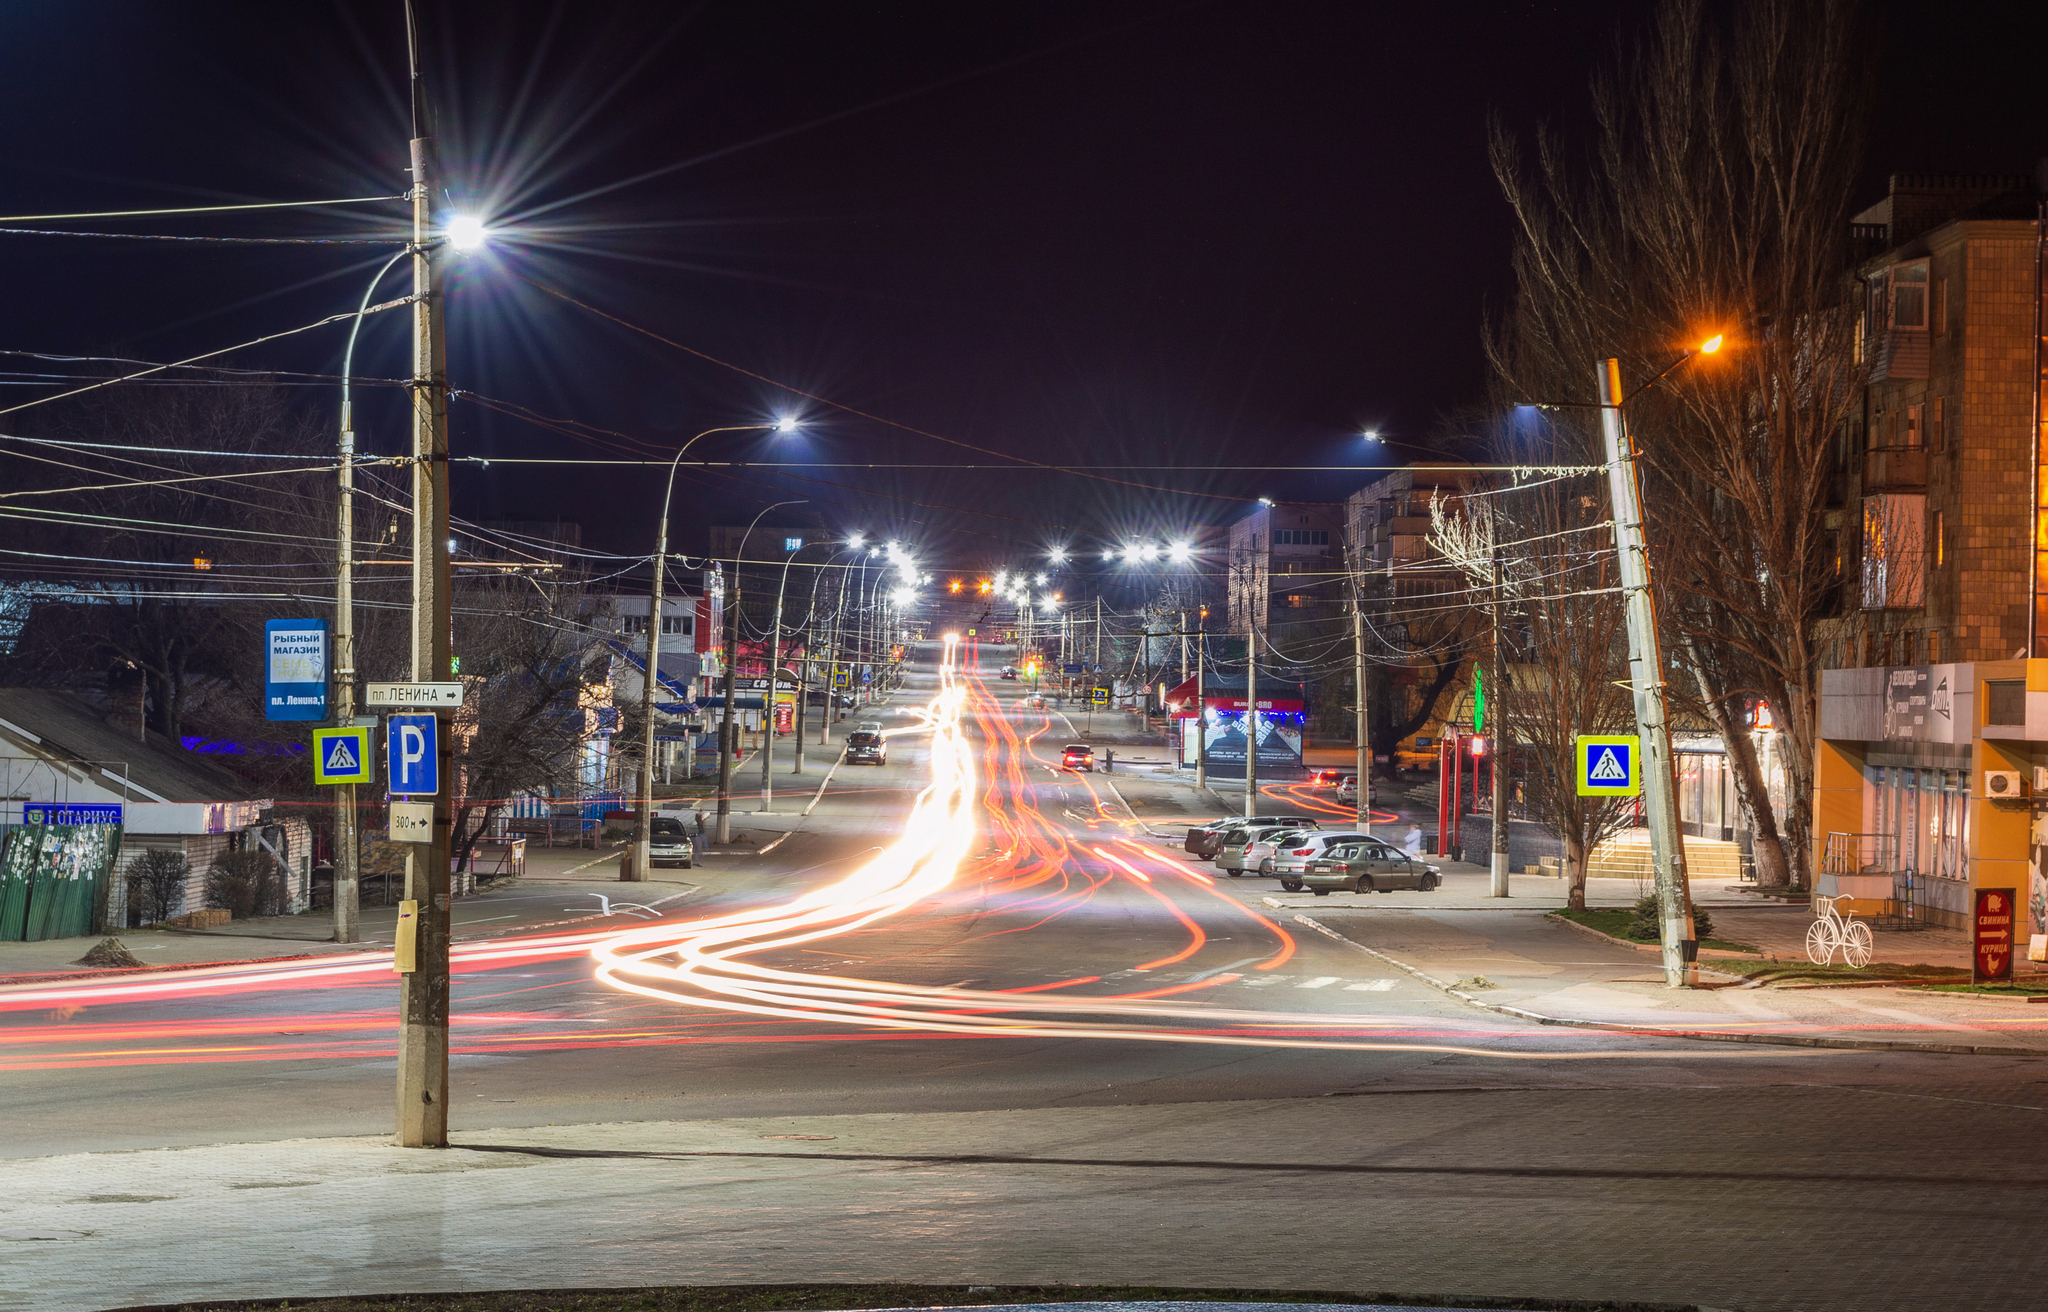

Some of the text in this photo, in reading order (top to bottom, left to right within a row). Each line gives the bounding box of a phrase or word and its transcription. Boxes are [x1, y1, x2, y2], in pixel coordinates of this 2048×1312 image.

[273, 633, 320, 643] РЫБНЫЙ
[273, 646, 320, 654] МАГАЗИН
[273, 658, 310, 669] СЕМЬ
[372, 688, 438, 701] пл. ЛЕНИНА
[271, 697, 285, 705] пл.
[1258, 701, 1272, 709] BRO
[47, 809, 117, 826] НОТАРИУС
[395, 816, 410, 828] 300
[1979, 916, 2010, 925] СВИНИНА
[1980, 943, 2008, 955] КУРИЦА
